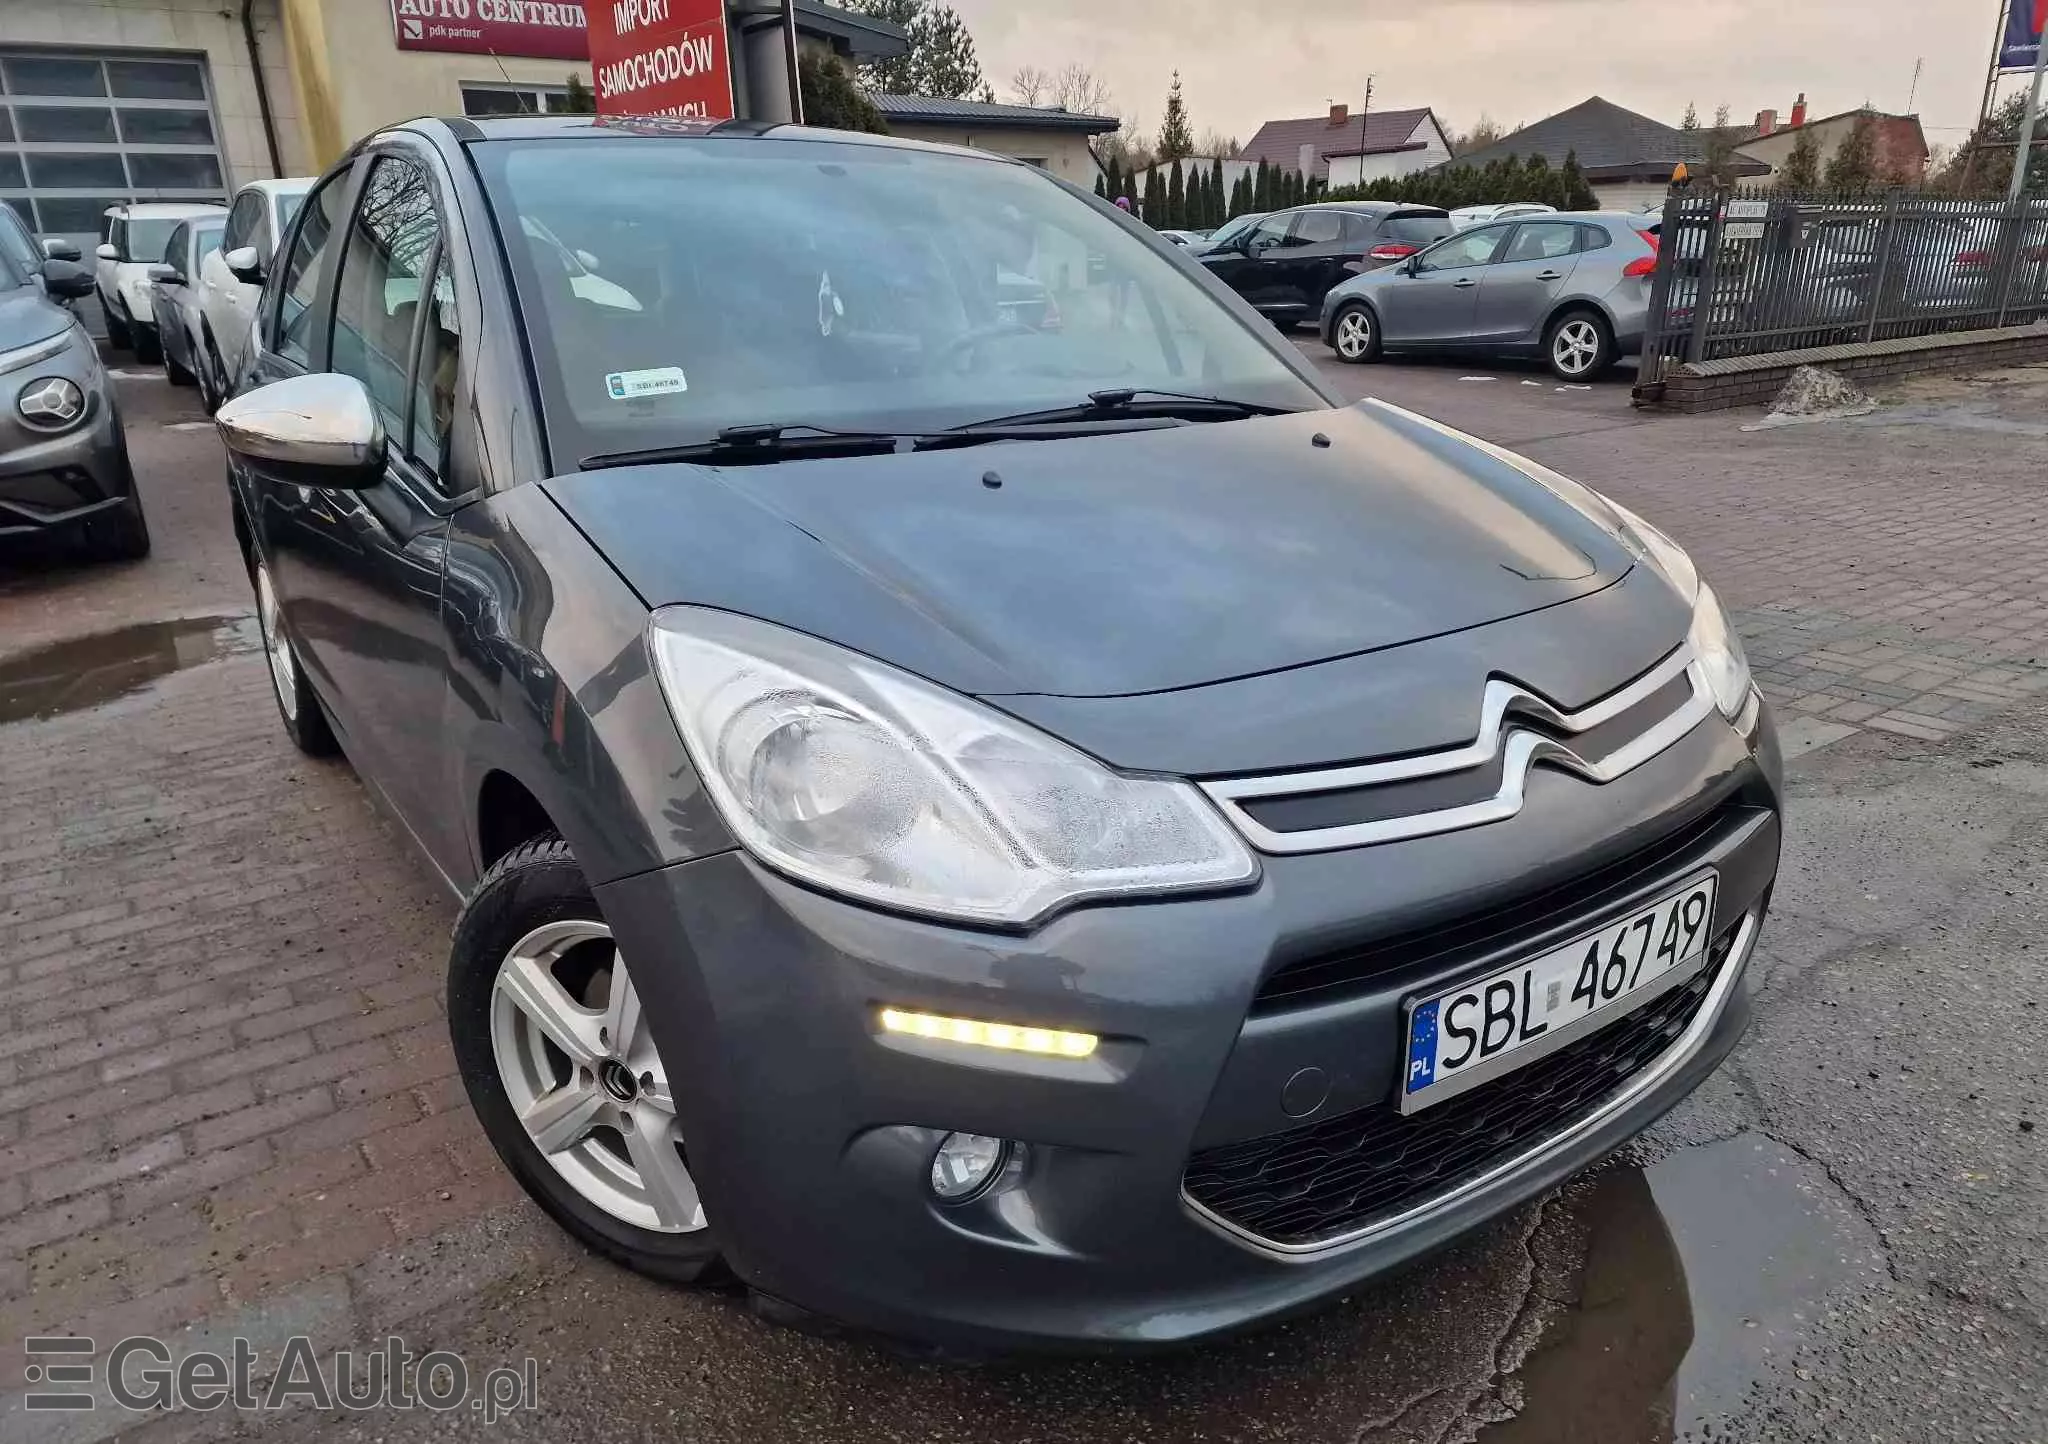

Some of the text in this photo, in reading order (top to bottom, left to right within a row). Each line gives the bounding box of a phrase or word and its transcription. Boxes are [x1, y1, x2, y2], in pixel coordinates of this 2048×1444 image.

[429, 24, 481, 39] pdk partner
[599, 31, 713, 99] SAMOCHODÓW
[1442, 891, 1707, 1069] SBL 46749
[1410, 1059, 1431, 1081] PL
